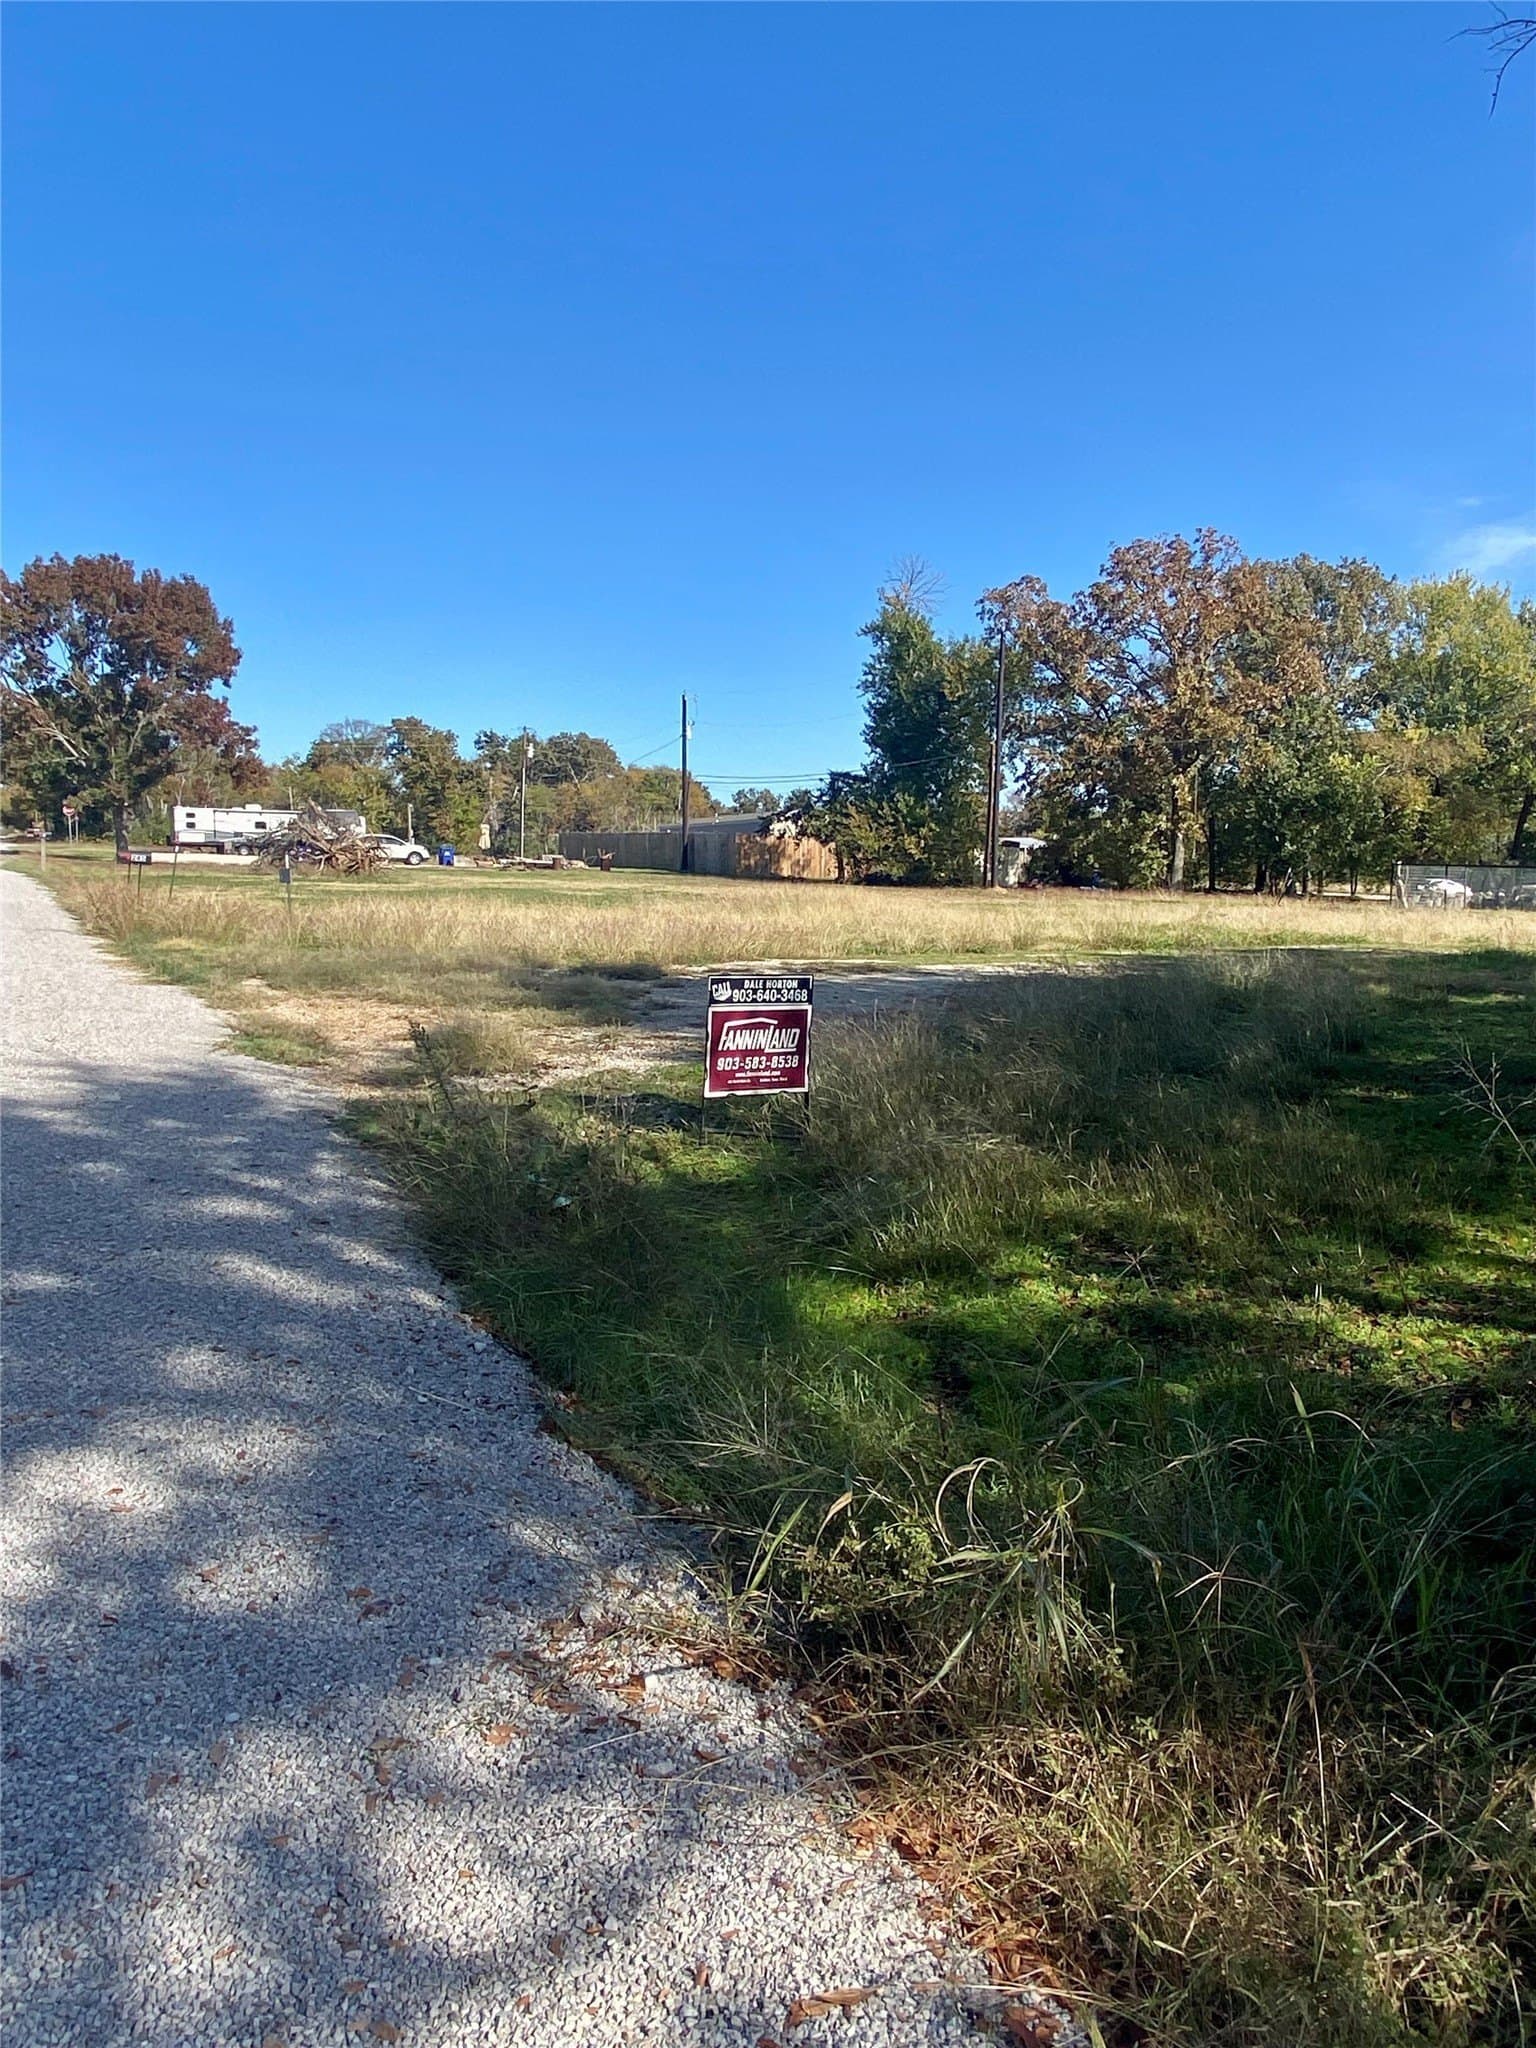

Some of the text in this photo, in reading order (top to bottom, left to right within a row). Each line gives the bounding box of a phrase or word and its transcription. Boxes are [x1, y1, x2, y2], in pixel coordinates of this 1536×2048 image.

[743, 979, 798, 989] DALE HORTON
[733, 989, 808, 1002] 903-640-3468
[716, 1055, 799, 1071] 903-583-8538
